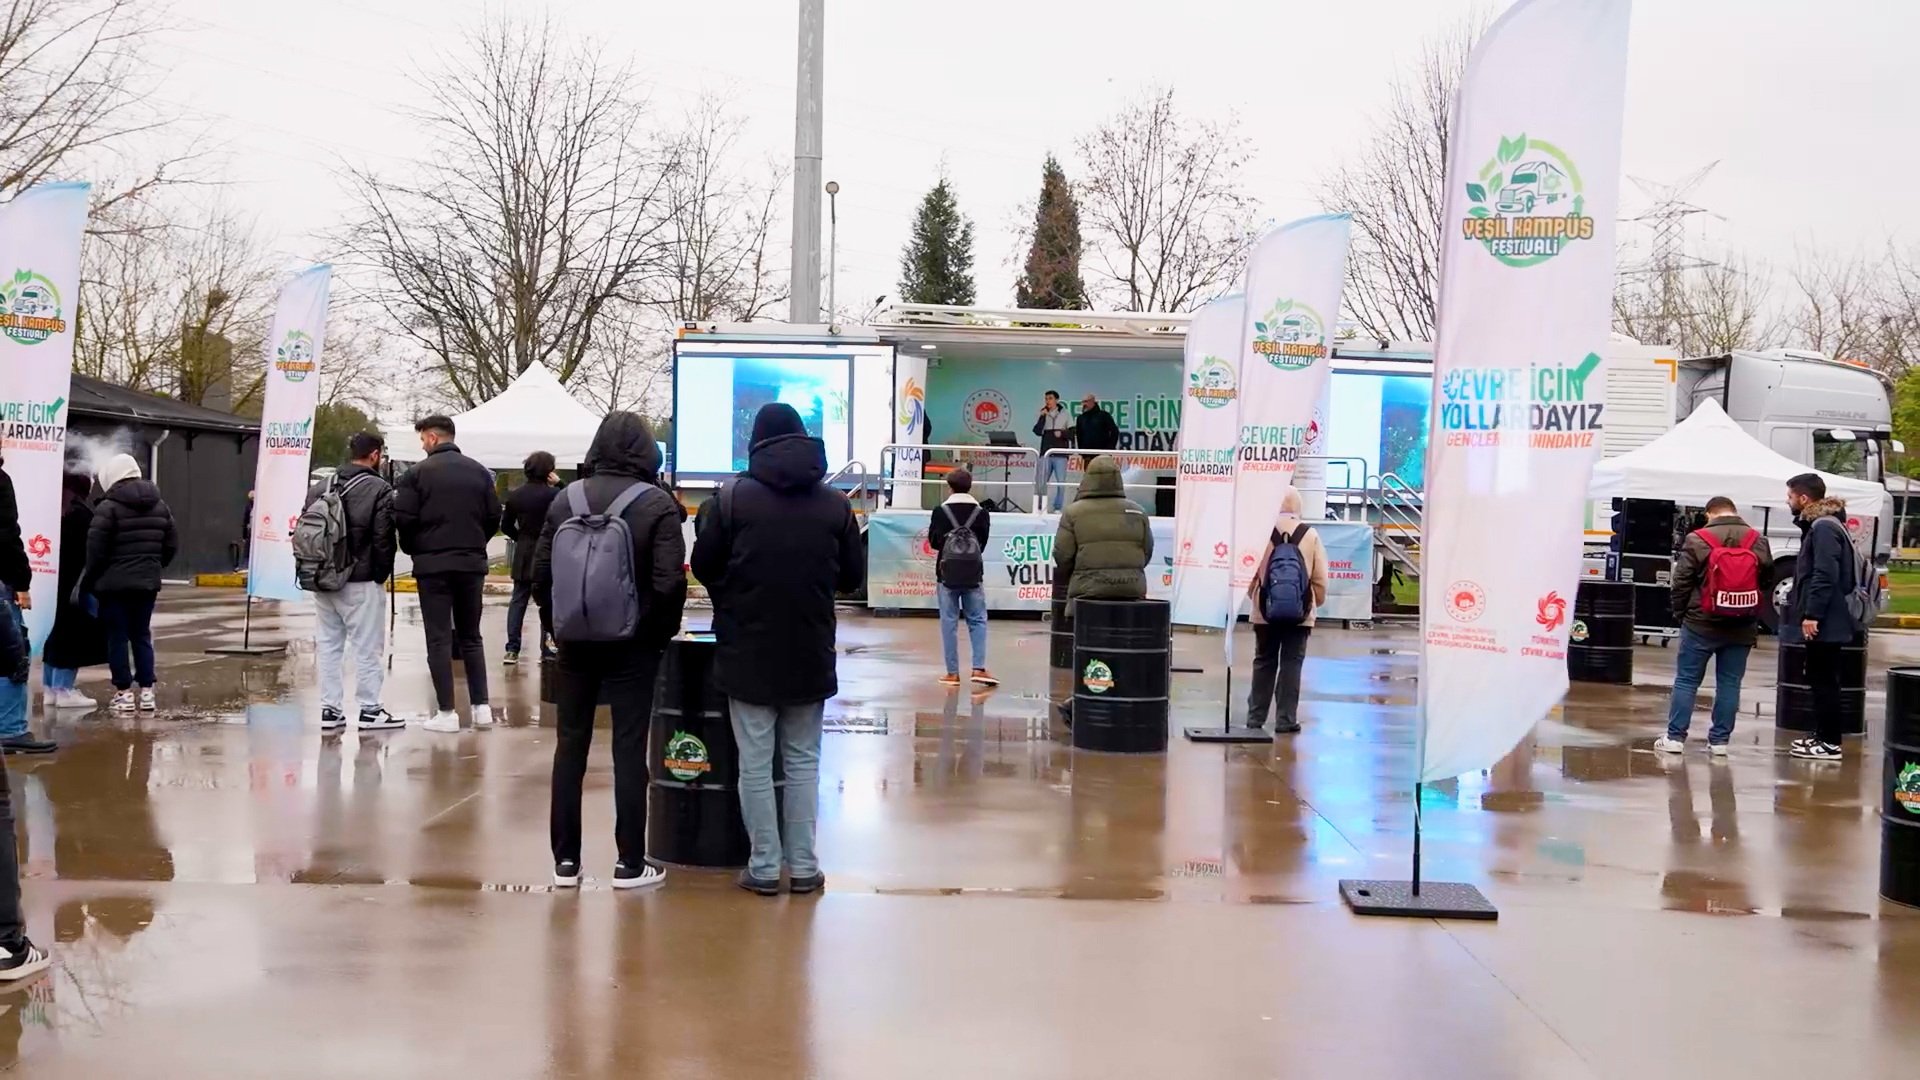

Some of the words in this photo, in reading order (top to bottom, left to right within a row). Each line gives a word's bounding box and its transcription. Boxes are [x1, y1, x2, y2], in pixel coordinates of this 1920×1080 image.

[1463, 213, 1508, 241] YEŞİL
[1513, 212, 1593, 239] KAMPÜS
[1253, 340, 1281, 354] YEŞİL
[1284, 342, 1328, 359] KAMPÜS
[1530, 362, 1584, 408] İÇİN
[1720, 592, 1756, 606] PUMA
